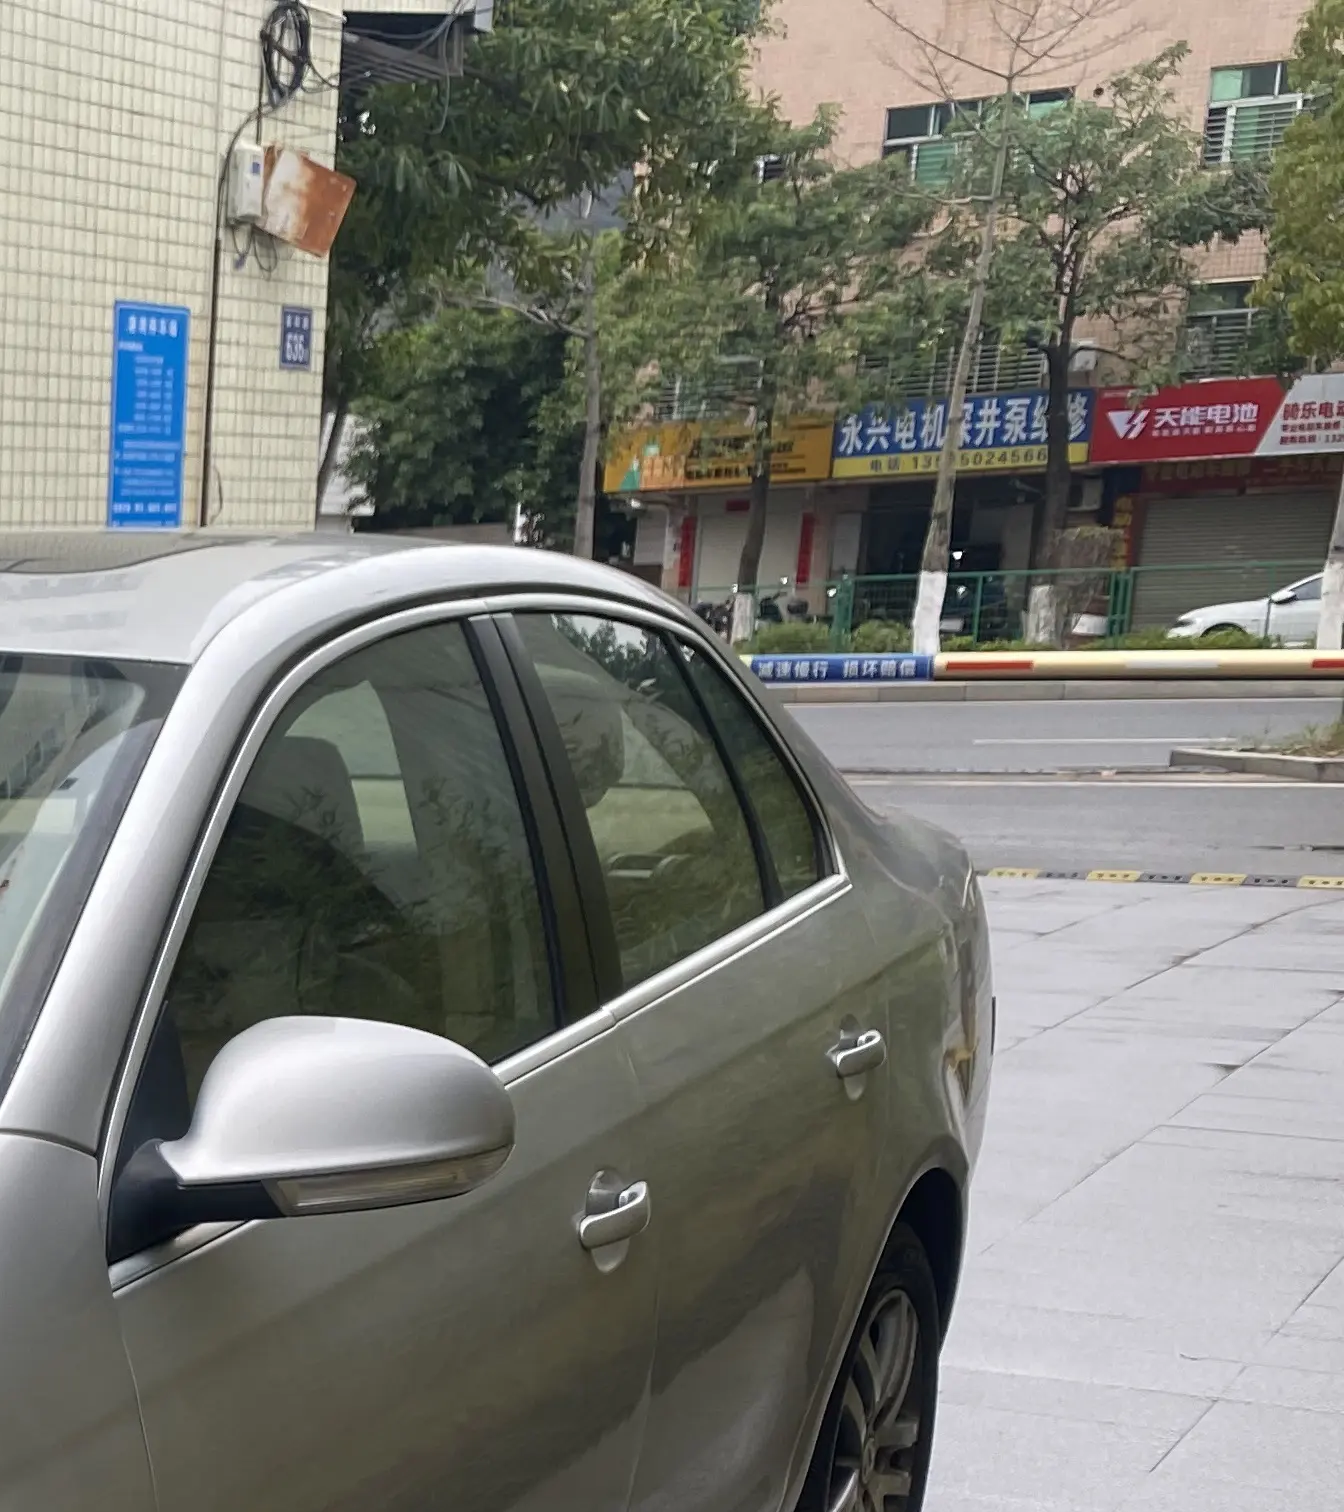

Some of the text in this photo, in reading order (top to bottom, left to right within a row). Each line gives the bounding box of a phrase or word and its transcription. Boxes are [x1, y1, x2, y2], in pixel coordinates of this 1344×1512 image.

[838, 394, 1088, 456] 永兴电机深井泵维修
[1154, 402, 1258, 429] 天能电池
[912, 448, 1048, 470] 135024566
